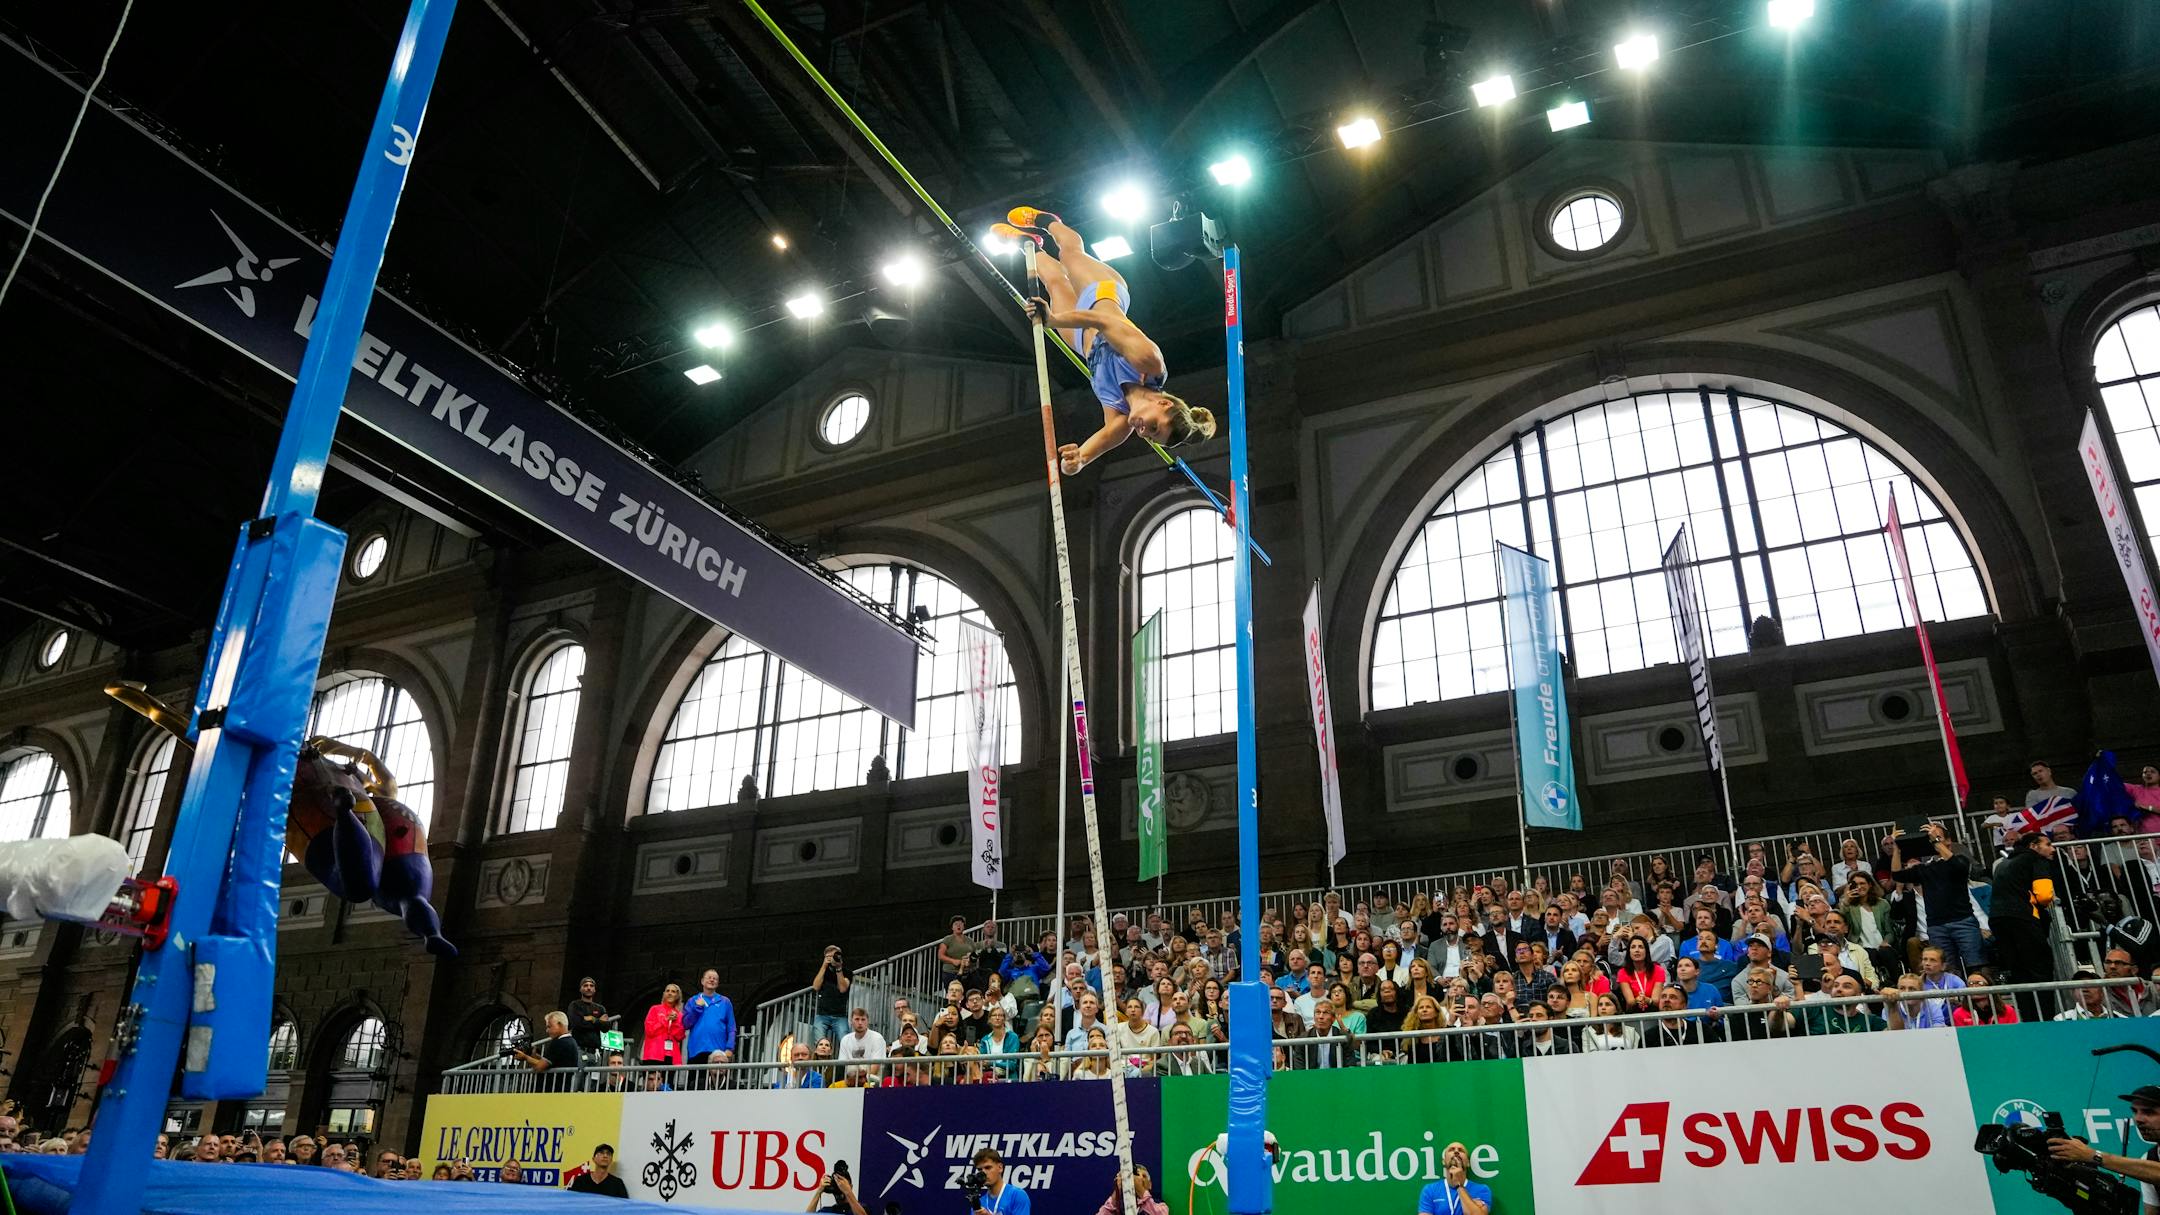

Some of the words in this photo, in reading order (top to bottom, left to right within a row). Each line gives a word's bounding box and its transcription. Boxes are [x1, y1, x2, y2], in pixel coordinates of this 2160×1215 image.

[384, 123, 413, 166] 3
[609, 493, 747, 598] ZÜRICH
[1537, 683, 1560, 767] Freude
[437, 1126, 462, 1161] LE
[711, 1130, 826, 1191] UBS
[1271, 1130, 1500, 1184] vaudoie
[1683, 1102, 1931, 1168] SWISS
